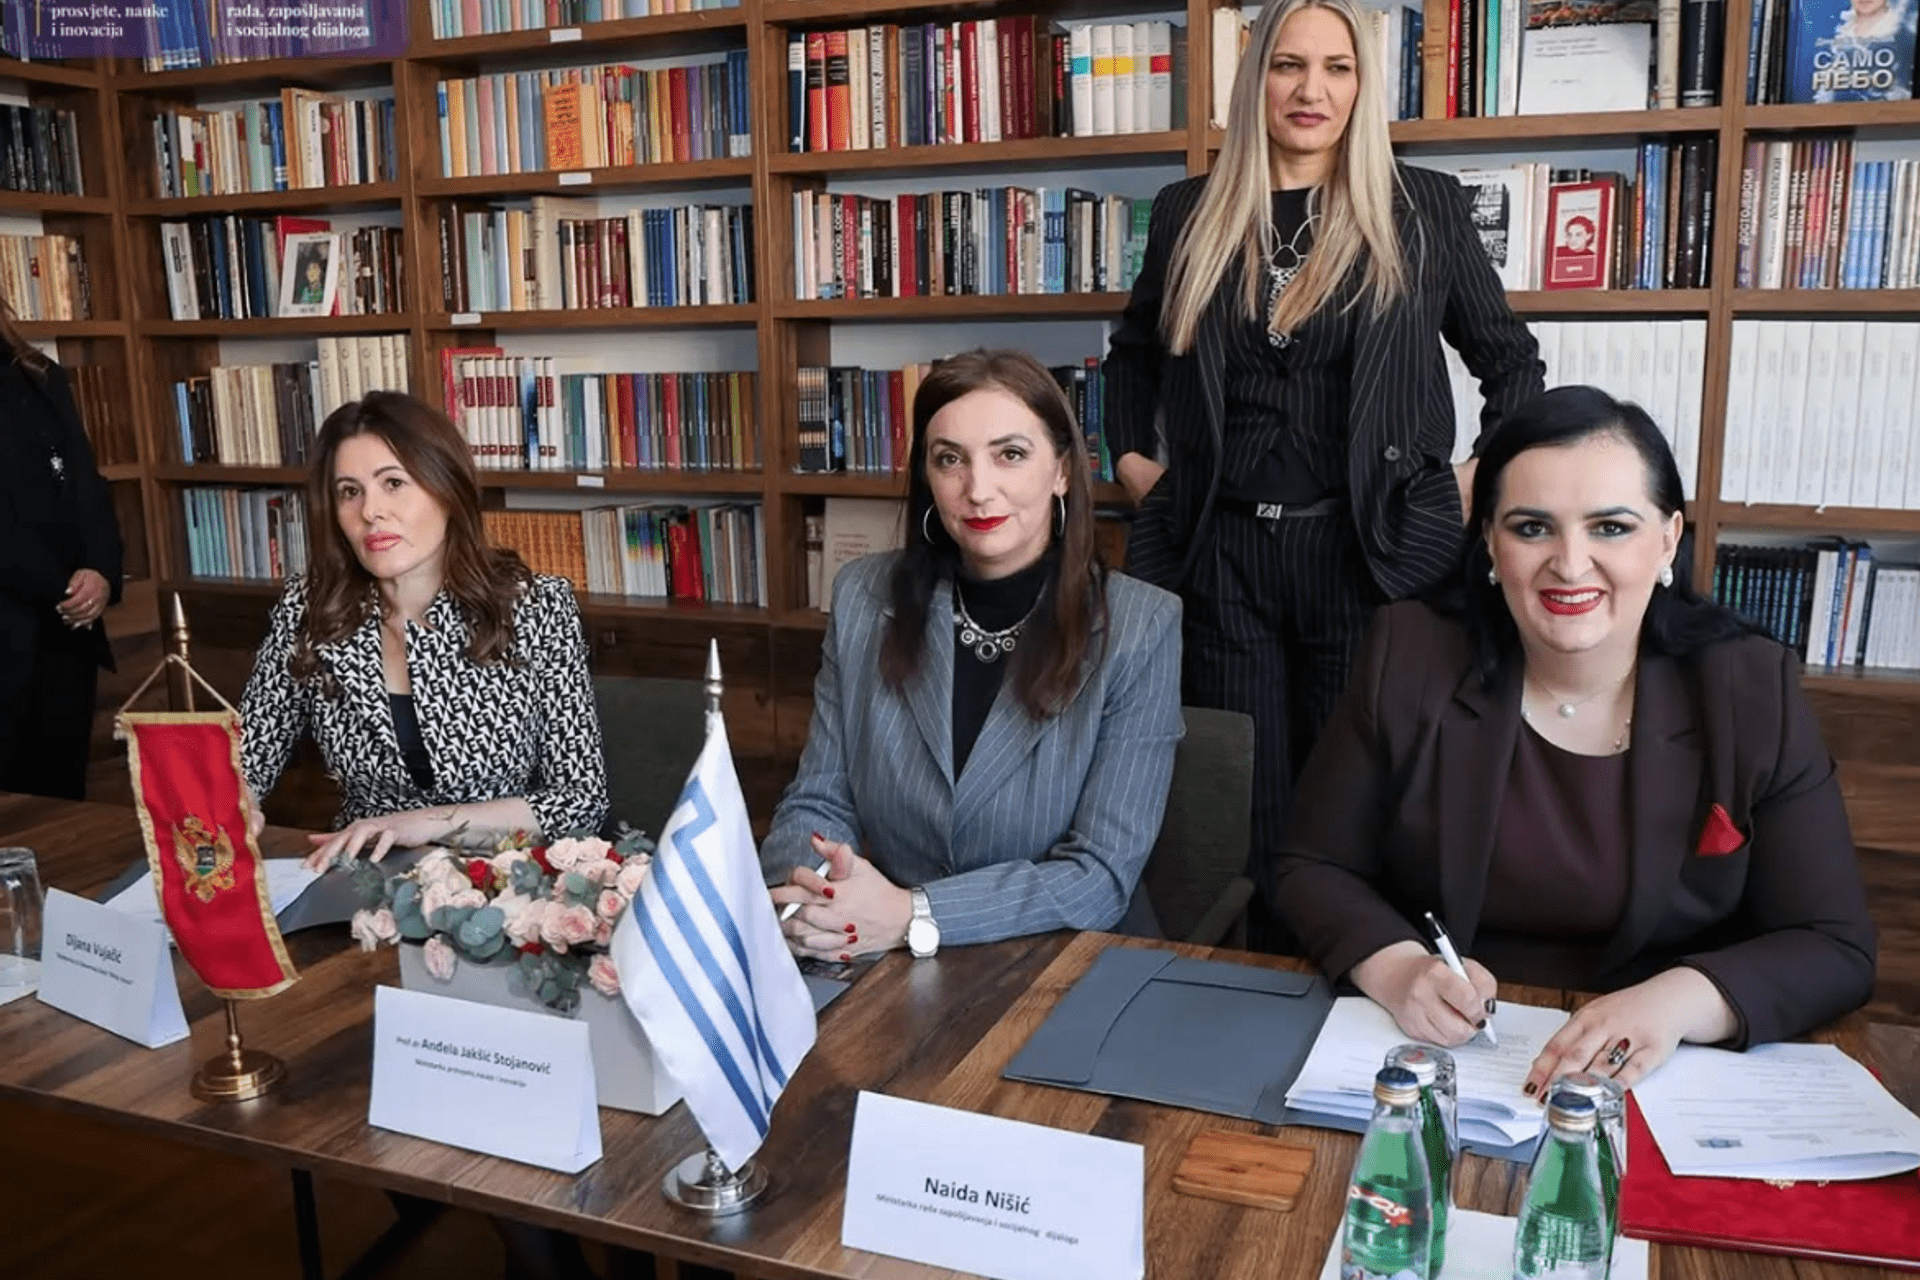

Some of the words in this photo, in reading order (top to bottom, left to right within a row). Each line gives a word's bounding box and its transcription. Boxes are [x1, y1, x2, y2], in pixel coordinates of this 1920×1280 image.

[1813, 48, 1895, 70] САМО
[1811, 69, 1894, 90] НЕБО
[493, 1052, 551, 1075] Stojanović
[924, 1177, 979, 1204] Naida
[985, 1189, 1032, 1214] Nišić
